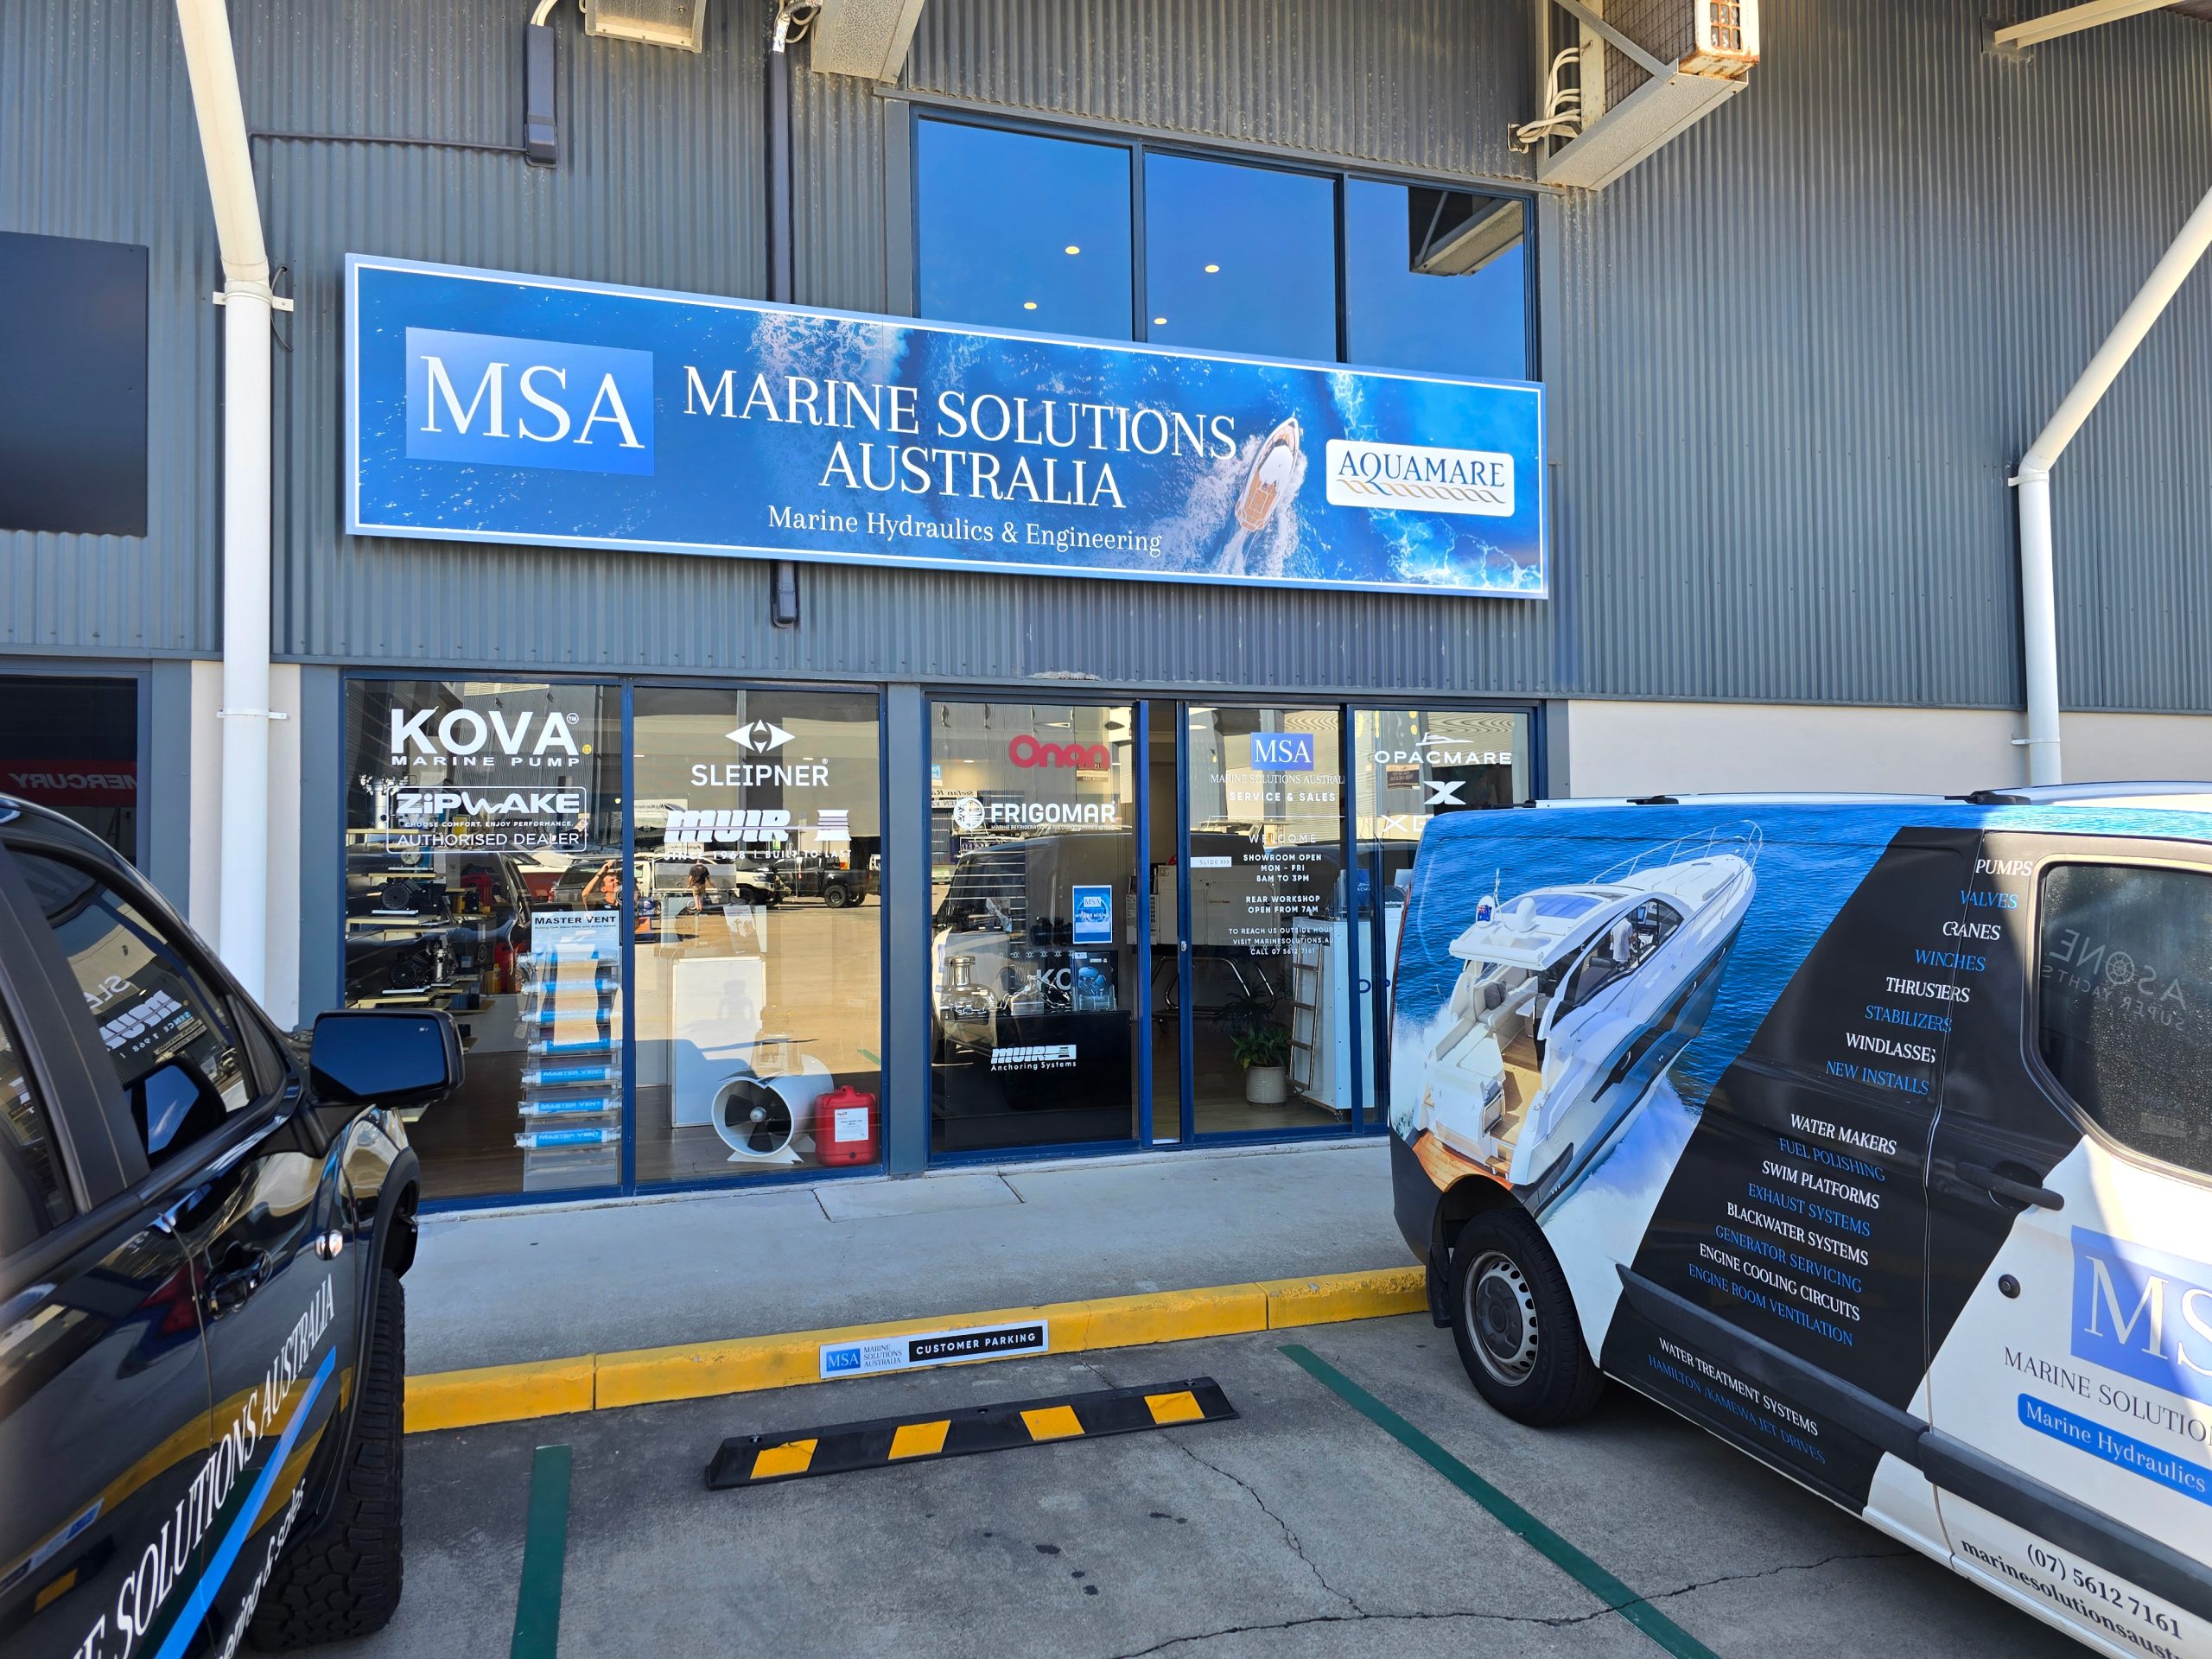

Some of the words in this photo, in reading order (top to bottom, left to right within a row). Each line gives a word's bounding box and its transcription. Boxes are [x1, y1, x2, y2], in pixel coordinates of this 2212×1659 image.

[420, 355, 645, 448] MSA
[683, 365, 919, 435] MARINE
[938, 390, 1236, 461] SOLUTIONS
[817, 440, 1126, 509] AUSTRALIA
[1338, 448, 1505, 495] AQUAMARE
[767, 505, 858, 534] Marine
[866, 512, 994, 544] Hydraulics
[1001, 521, 1019, 544] &
[1025, 523, 1162, 557] Engineering
[391, 708, 580, 756] KOVA
[391, 756, 495, 767] MARINE
[512, 757, 580, 767] PUMP
[1008, 734, 1110, 769] Onan
[1255, 739, 1312, 763] MSA
[1374, 750, 1512, 765] OPACMARE
[691, 764, 830, 787] SLEIPNER
[1211, 774, 1248, 784] MARINE
[1249, 774, 1301, 785] SOLUTIONS
[1230, 791, 1281, 802] SERVICE
[1287, 791, 1294, 802] &
[1299, 791, 1336, 802] SALES
[663, 810, 791, 842] MUIR
[991, 803, 1116, 823] FRIGOMAR
[397, 833, 508, 846] AUTHORISED
[513, 833, 579, 845] DEALER
[1249, 834, 1317, 844] WELCOME
[712, 850, 746, 860] 1968
[765, 849, 797, 859] BUILT
[804, 849, 819, 858] TO
[825, 849, 852, 858] LAST
[1975, 859, 2032, 877] PUMPS
[1245, 895, 1268, 904] REAR
[1960, 890, 2018, 910] VALVES
[1942, 920, 2001, 941] CRANES
[1915, 949, 1986, 972] WINCHES
[1886, 977, 1970, 1002] THRUSTERS
[1865, 1005, 1952, 1033] STABILIZERS
[990, 1045, 1046, 1064] MUIR
[990, 1062, 1038, 1071] Anchoring
[1040, 1060, 1077, 1070] Systems
[1826, 1060, 1859, 1079] NEW
[1862, 1067, 1929, 1096] INSTALLS
[1790, 1113, 1834, 1139] WATER
[1838, 1126, 1897, 1155] MAKERS
[1779, 1137, 1810, 1159] FUEL
[1813, 1147, 1885, 1182] POLISHING
[1762, 1160, 1797, 1184] SWIM
[1801, 1175, 1880, 1210] PLATFORMS
[1748, 1183, 1805, 1213] EXHAUST
[1808, 1204, 1871, 1237] SYSTEMS
[1727, 1201, 1805, 1243] BLACKWATER
[1808, 1231, 1869, 1266] SYSTEMS
[1715, 1224, 1787, 1264] GENERATOR
[1789, 1254, 1862, 1294] SERVICING
[1699, 1243, 1741, 1273] ENGINE
[1743, 1262, 1797, 1295] COOLING
[1800, 1285, 1860, 1321] CIRCUITS
[1688, 1262, 1729, 1293] ENGINE
[1732, 1281, 1766, 1309] ROOM
[1770, 1298, 1853, 1347] VENTILATION
[864, 1344, 891, 1353] MARINE
[864, 1350, 903, 1360] SOLUTIONS
[916, 1339, 979, 1355] CUSTOMER
[984, 1332, 1036, 1347] PARKING
[827, 1353, 860, 1368] MSA
[864, 1357, 902, 1368] AUSTRALIA
[2004, 1345, 2091, 1400] MARINE
[1659, 1337, 1695, 1368] WATER
[1695, 1357, 1760, 1404] TREATMENT
[1763, 1395, 1819, 1437] SYSTEMS
[1648, 1354, 1701, 1394] HAMILTON
[1758, 1416, 1777, 1438] JET
[1780, 1428, 1826, 1465] DRIVES
[2026, 1401, 2091, 1445] Marine
[2097, 1435, 2206, 1493] Hydraulics
[117, 1389, 257, 1659] SOLUTIONS
[259, 1273, 335, 1440] AUSTRALIA
[1961, 1537, 2183, 1659] marinesolutionsaust
[2027, 1542, 2067, 1580] (07)
[2072, 1567, 2123, 1609] 5612
[2127, 1596, 2183, 1640] 7161
